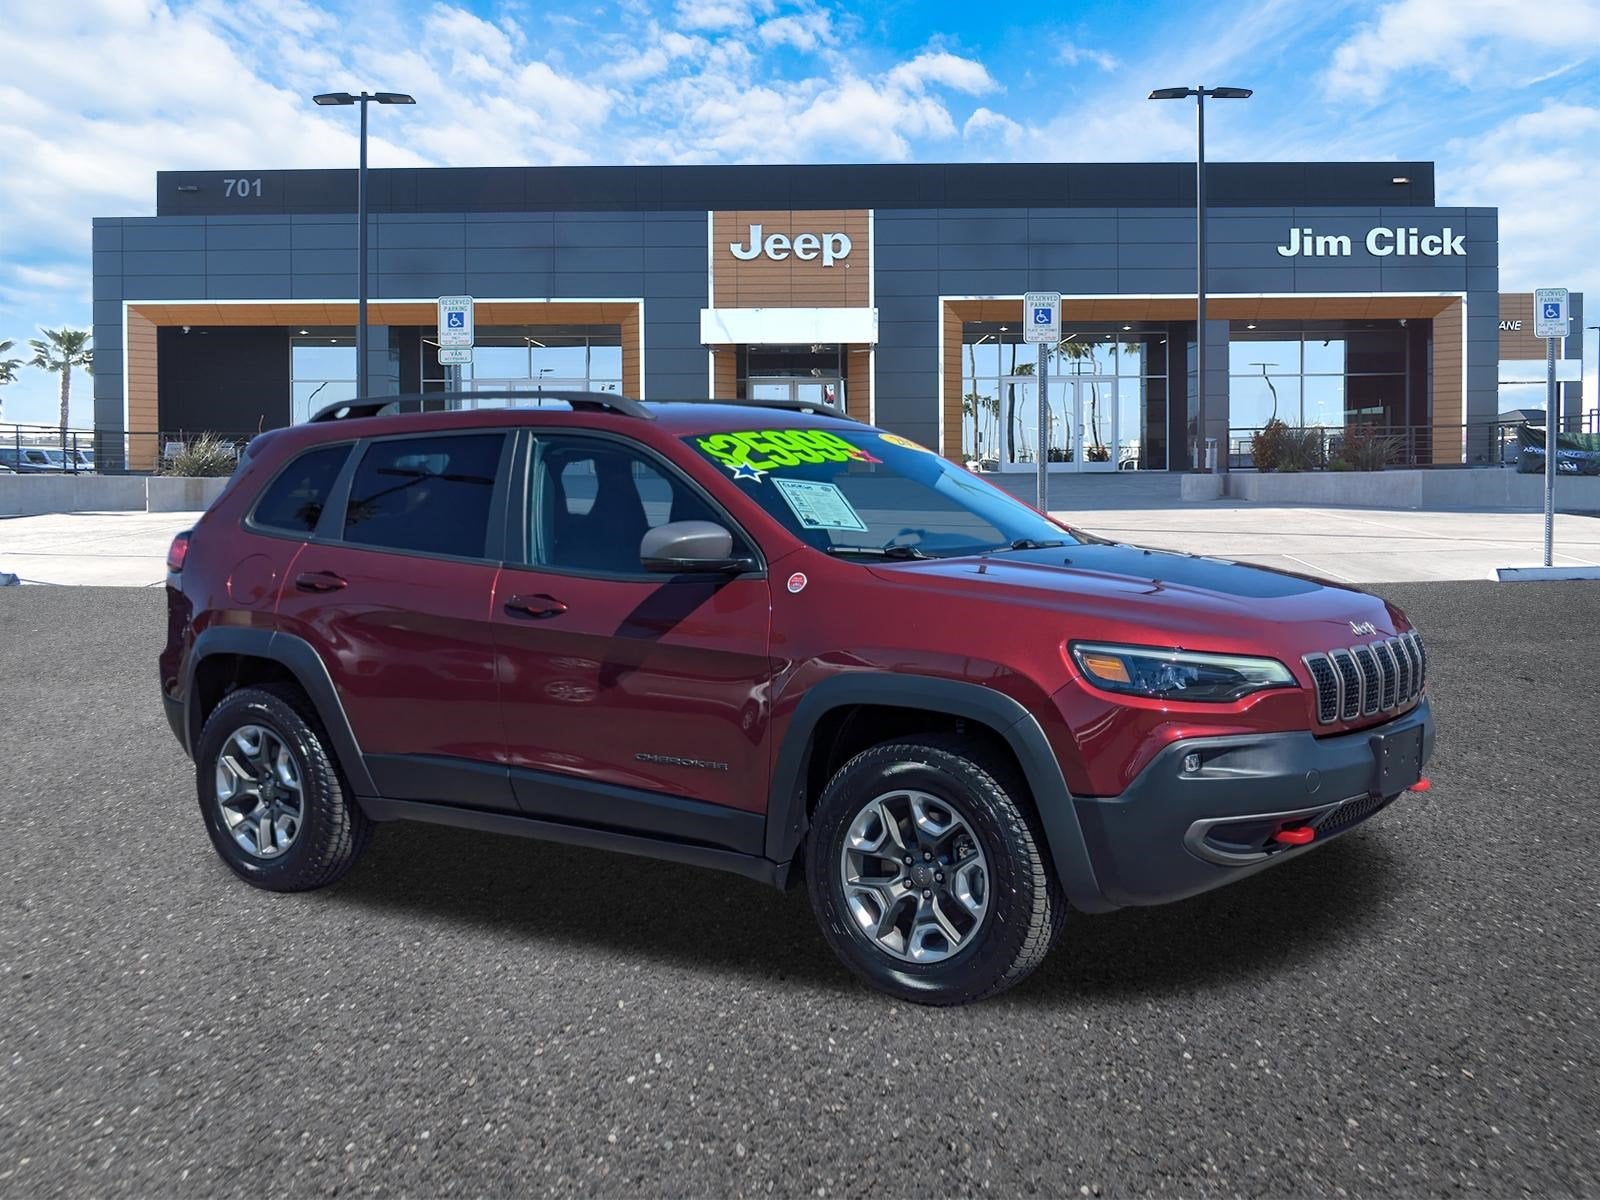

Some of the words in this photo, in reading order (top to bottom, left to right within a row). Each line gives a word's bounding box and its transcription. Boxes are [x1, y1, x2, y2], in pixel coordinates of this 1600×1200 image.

[223, 178, 262, 197] 701
[729, 223, 852, 268] Jeep
[1277, 227, 1352, 257] Jim
[1365, 226, 1467, 257] Click
[1349, 620, 1377, 636] Jeep
